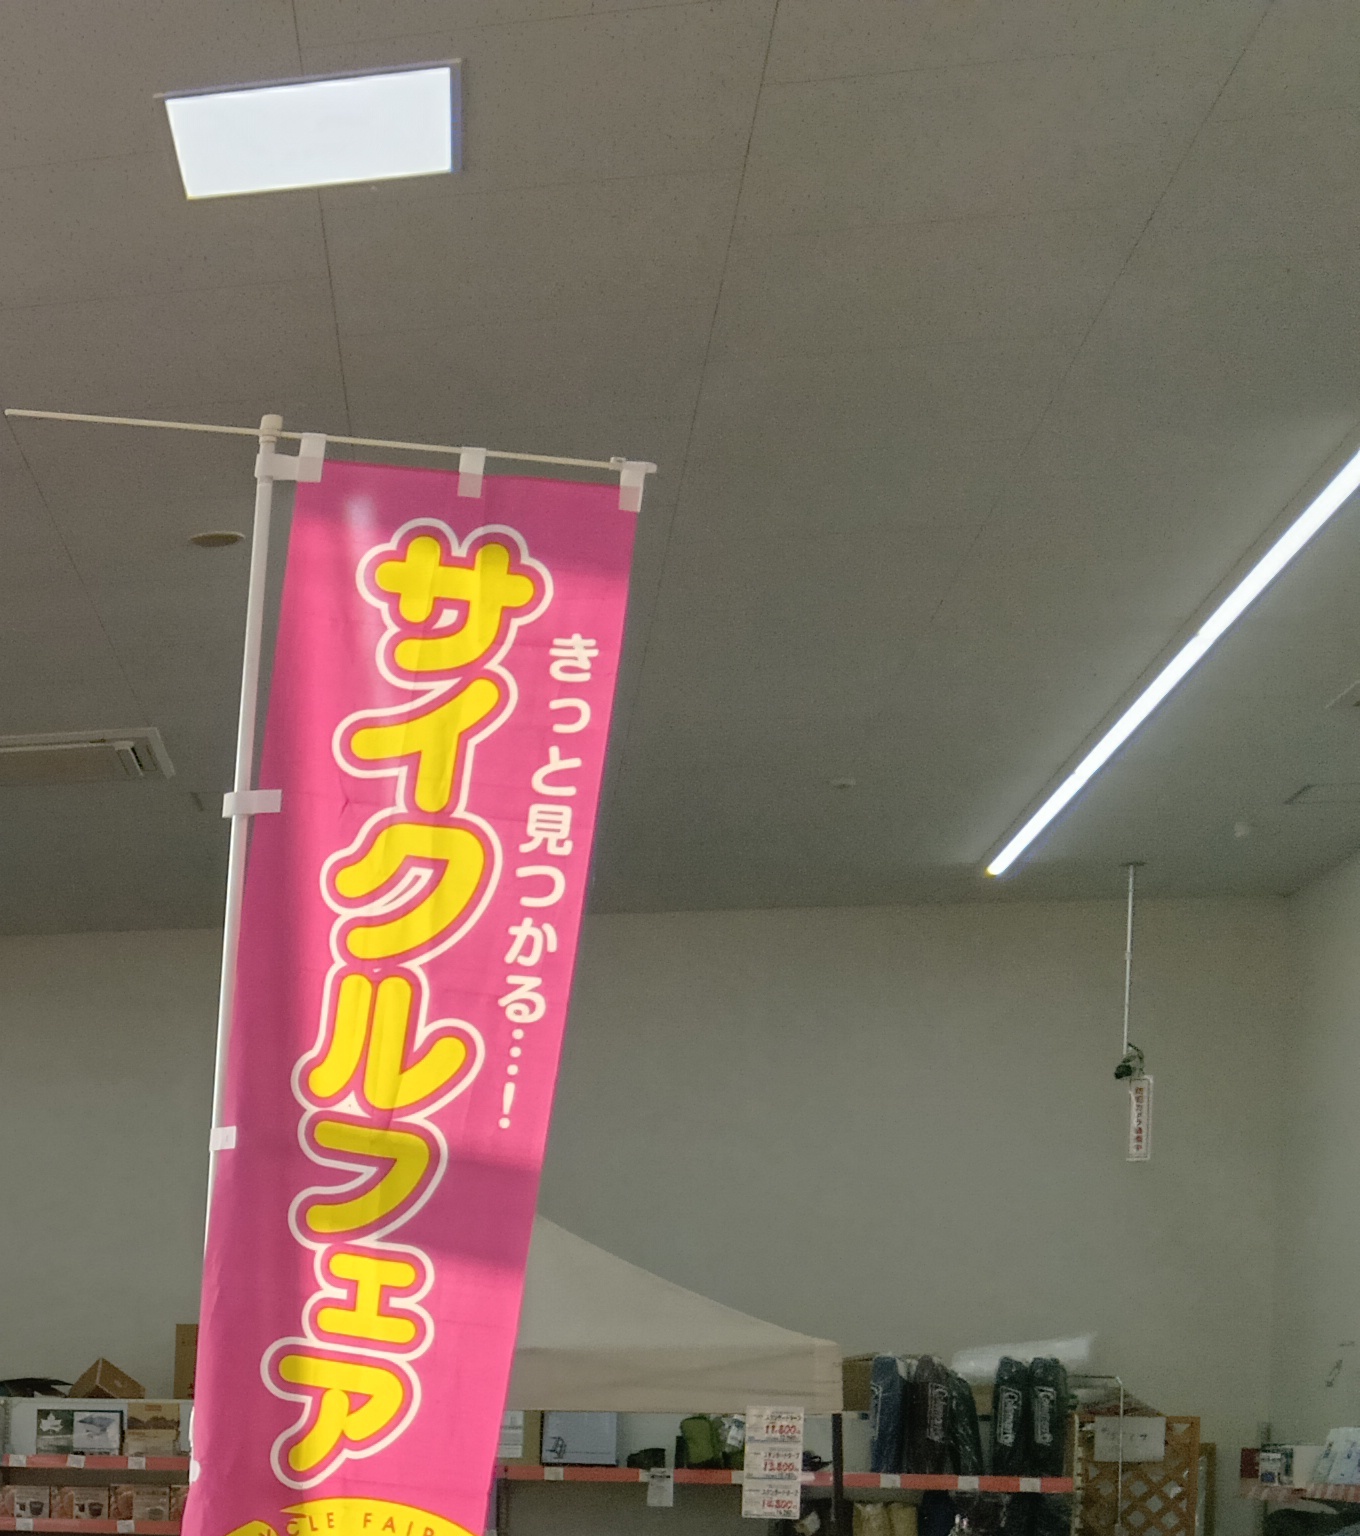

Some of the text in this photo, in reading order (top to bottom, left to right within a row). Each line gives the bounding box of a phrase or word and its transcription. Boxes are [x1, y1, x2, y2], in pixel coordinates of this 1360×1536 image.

[261, 518, 553, 1489] サイクルフェア
